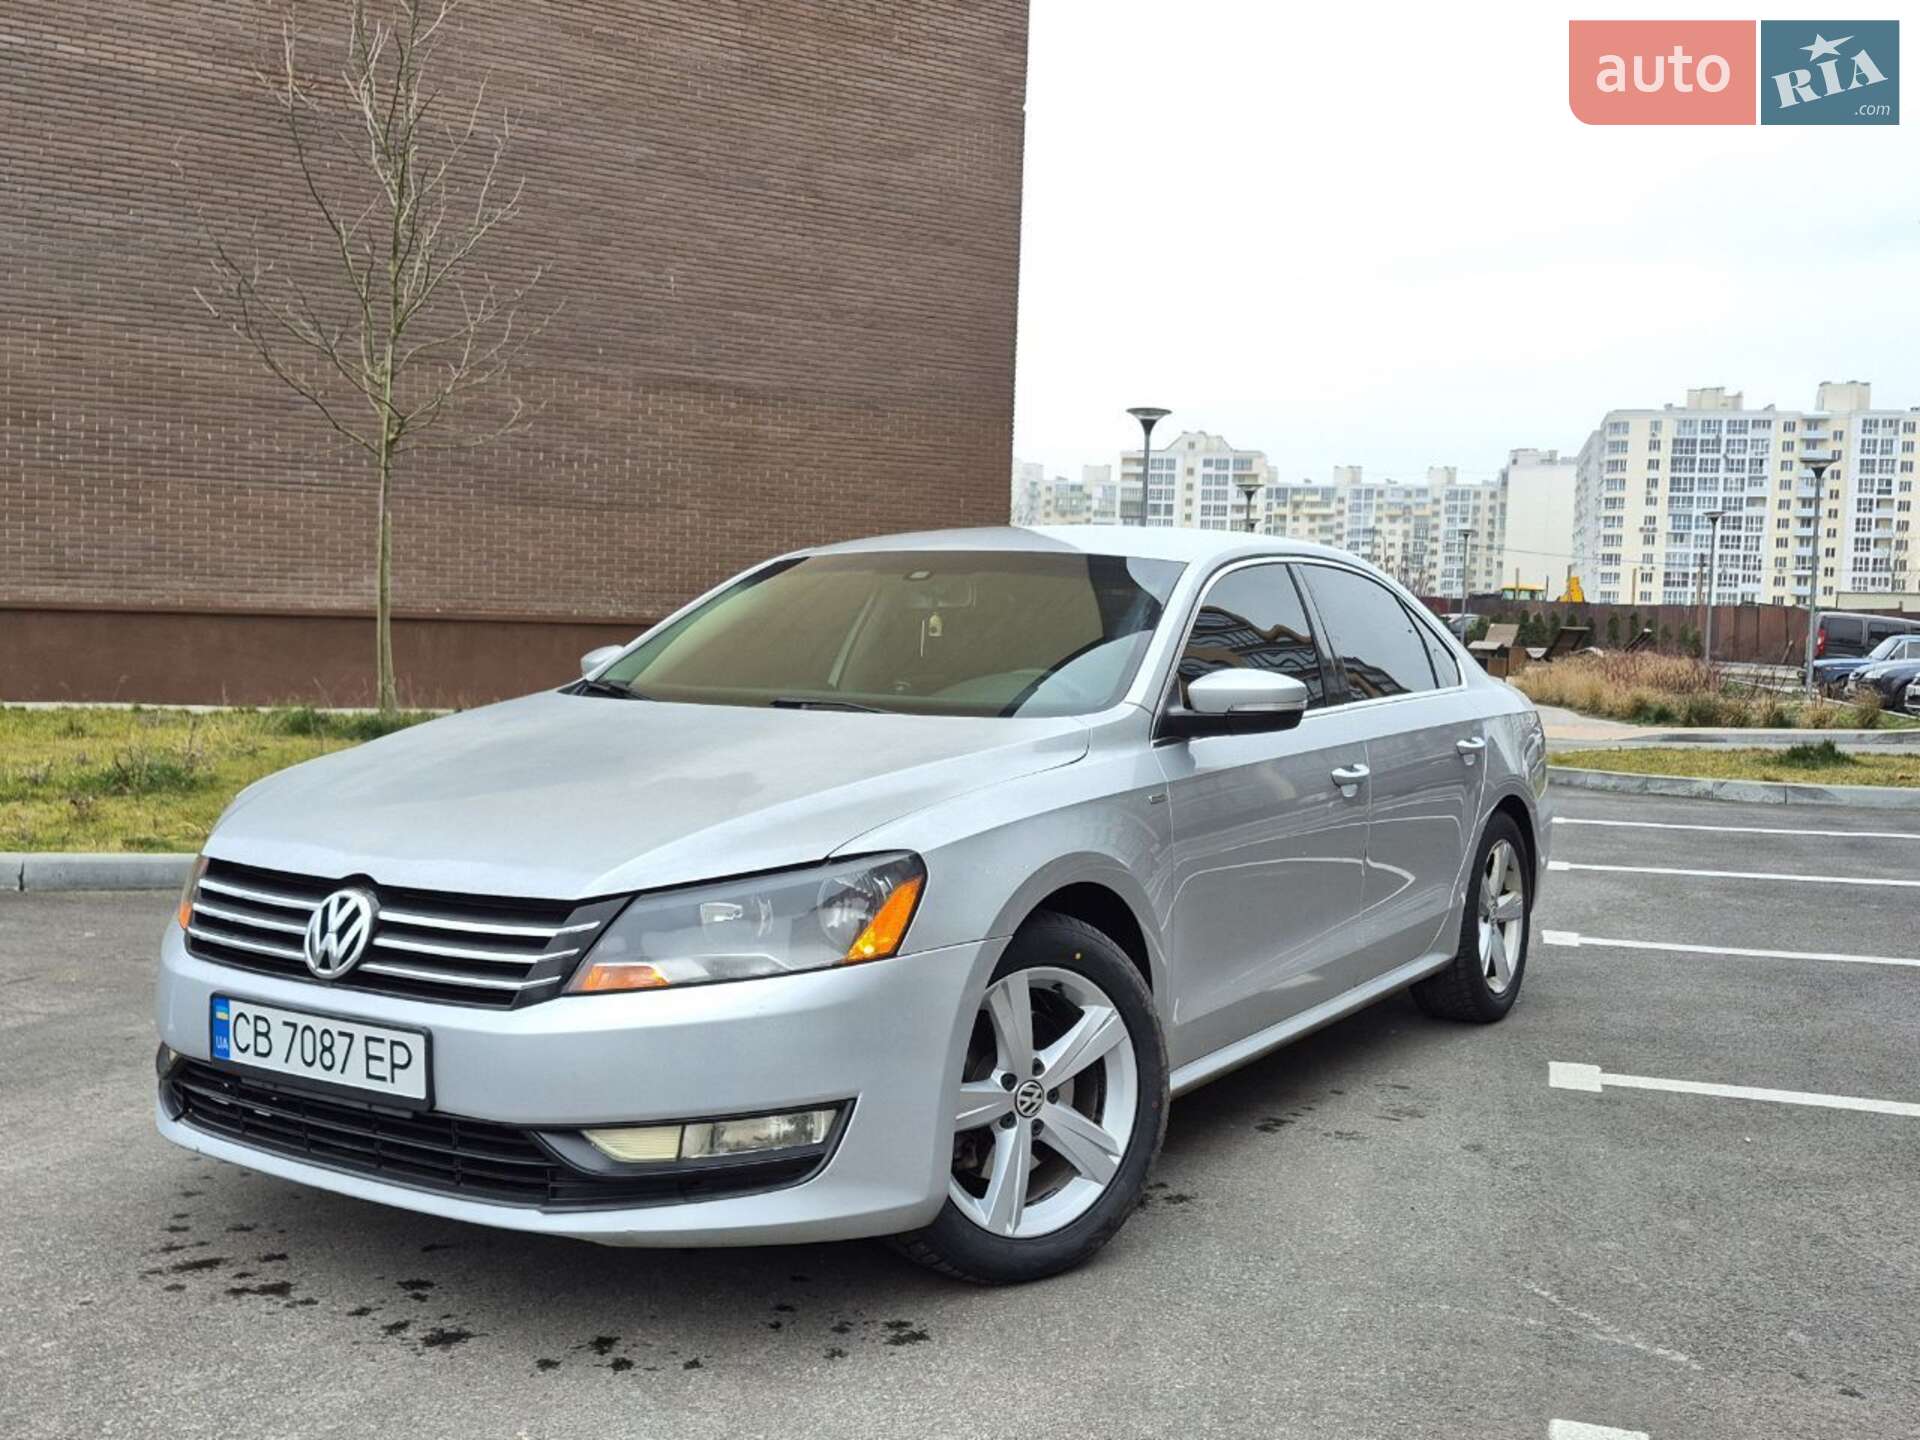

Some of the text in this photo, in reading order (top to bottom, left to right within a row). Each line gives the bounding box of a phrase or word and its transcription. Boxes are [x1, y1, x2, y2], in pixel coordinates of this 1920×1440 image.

[215, 1035, 229, 1050] UA
[233, 1012, 413, 1084] CB 7087 EP
